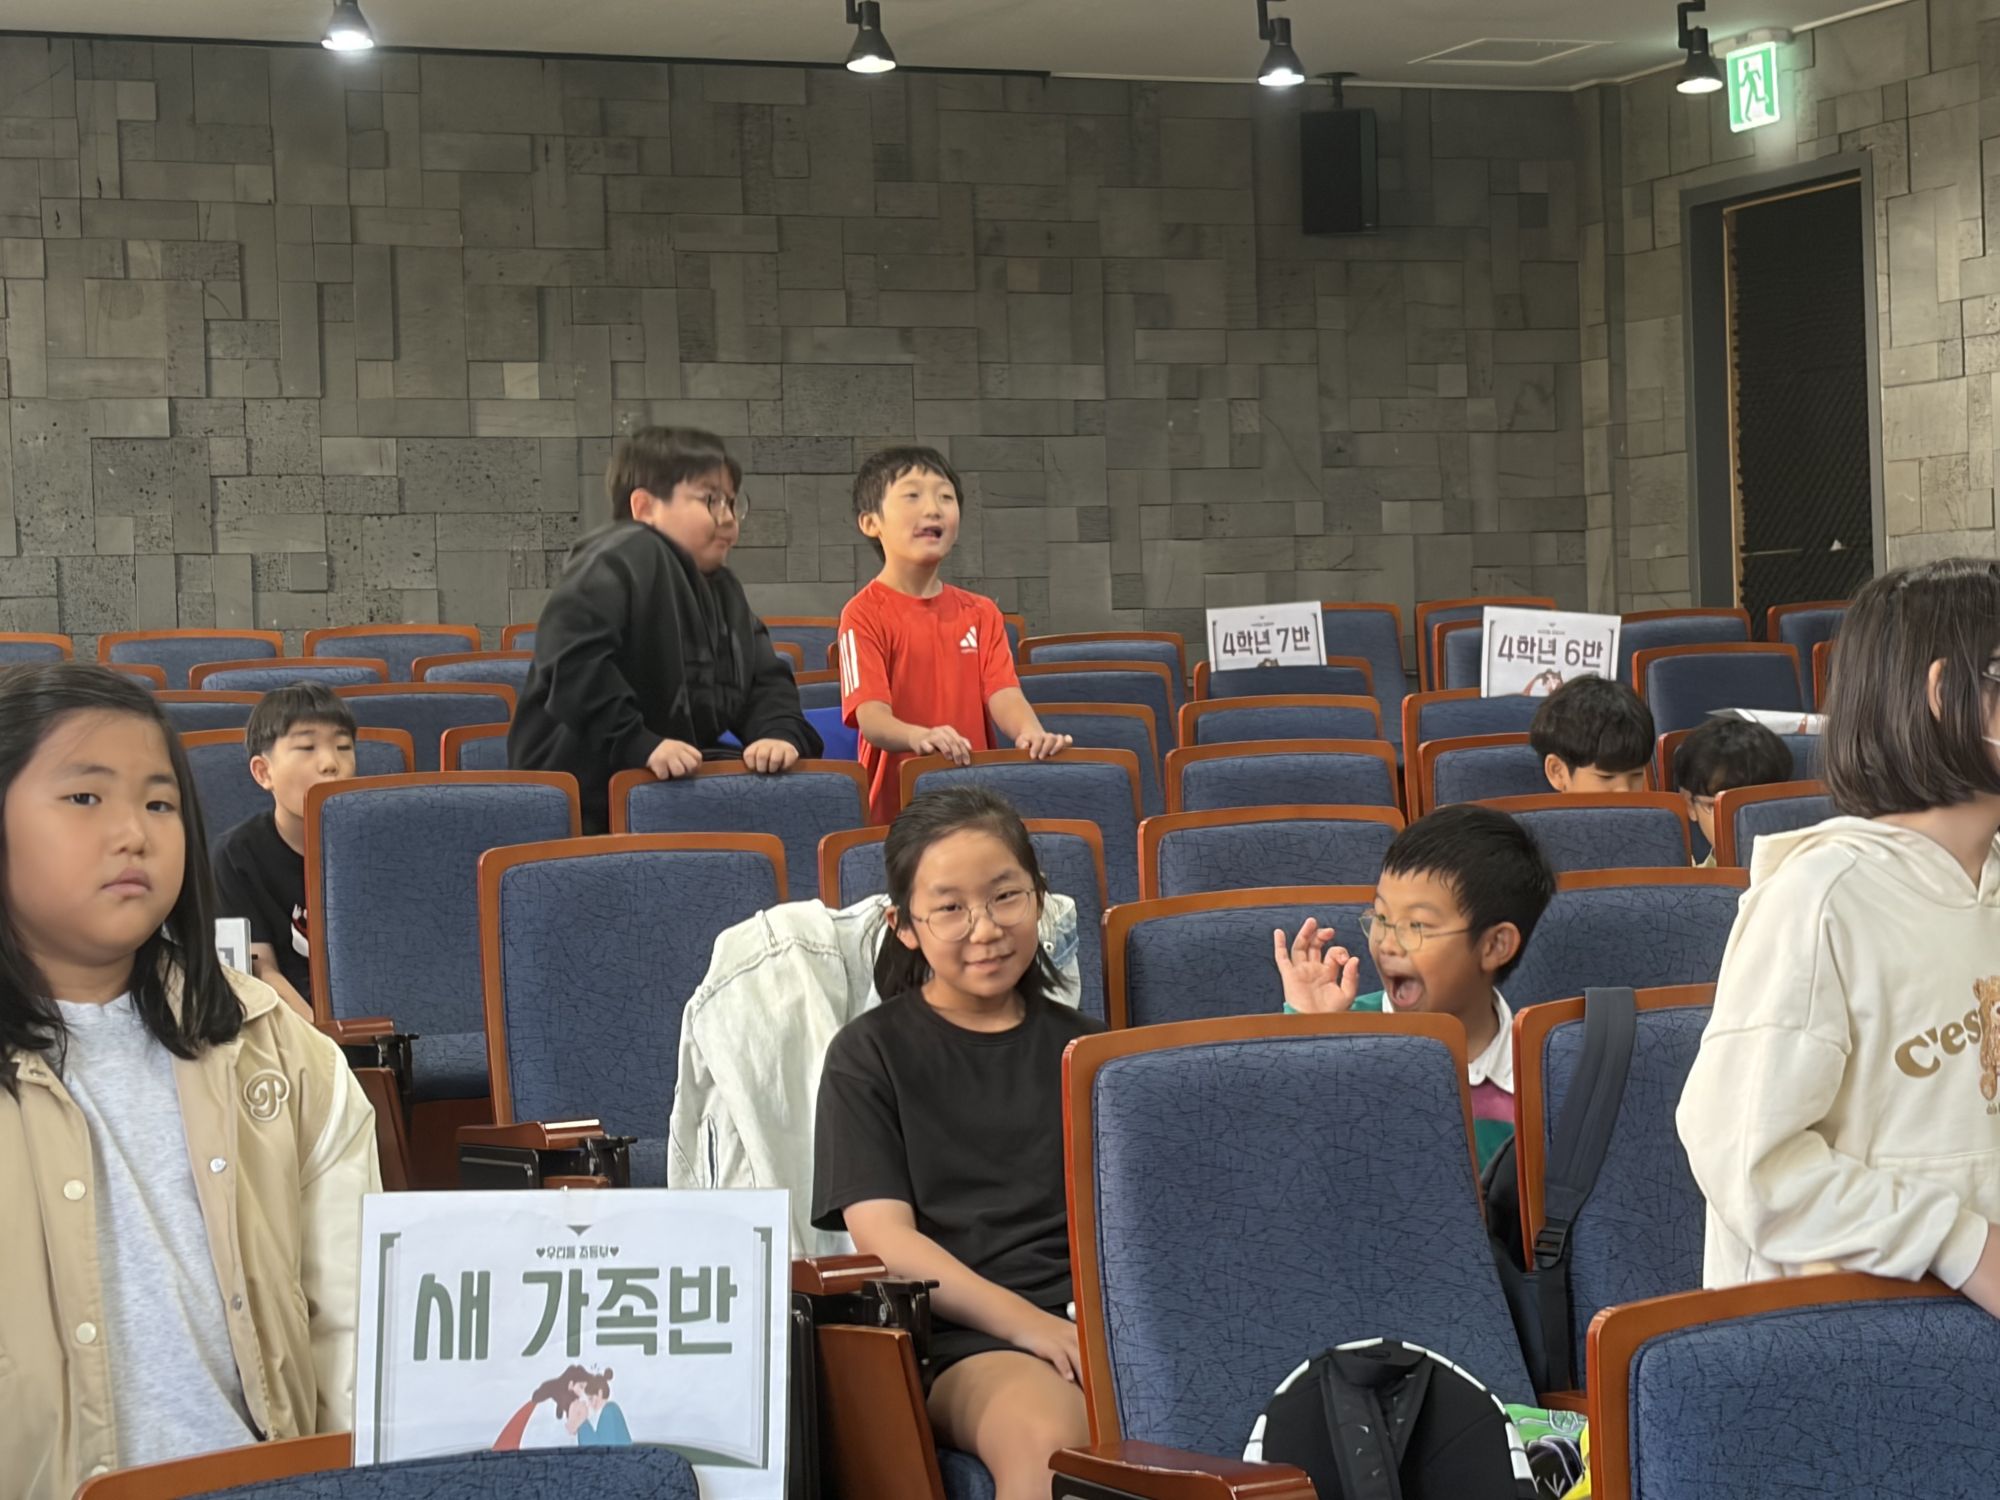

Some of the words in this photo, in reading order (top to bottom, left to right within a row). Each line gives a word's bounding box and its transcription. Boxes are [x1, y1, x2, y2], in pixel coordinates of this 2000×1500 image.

[1222, 629, 1272, 656] 4학년
[1276, 626, 1311, 652] 7반
[1498, 634, 1557, 665] 4학년
[1564, 639, 1603, 668] 6반
[413, 1270, 491, 1361] 새
[521, 1266, 738, 1358] 가족반
